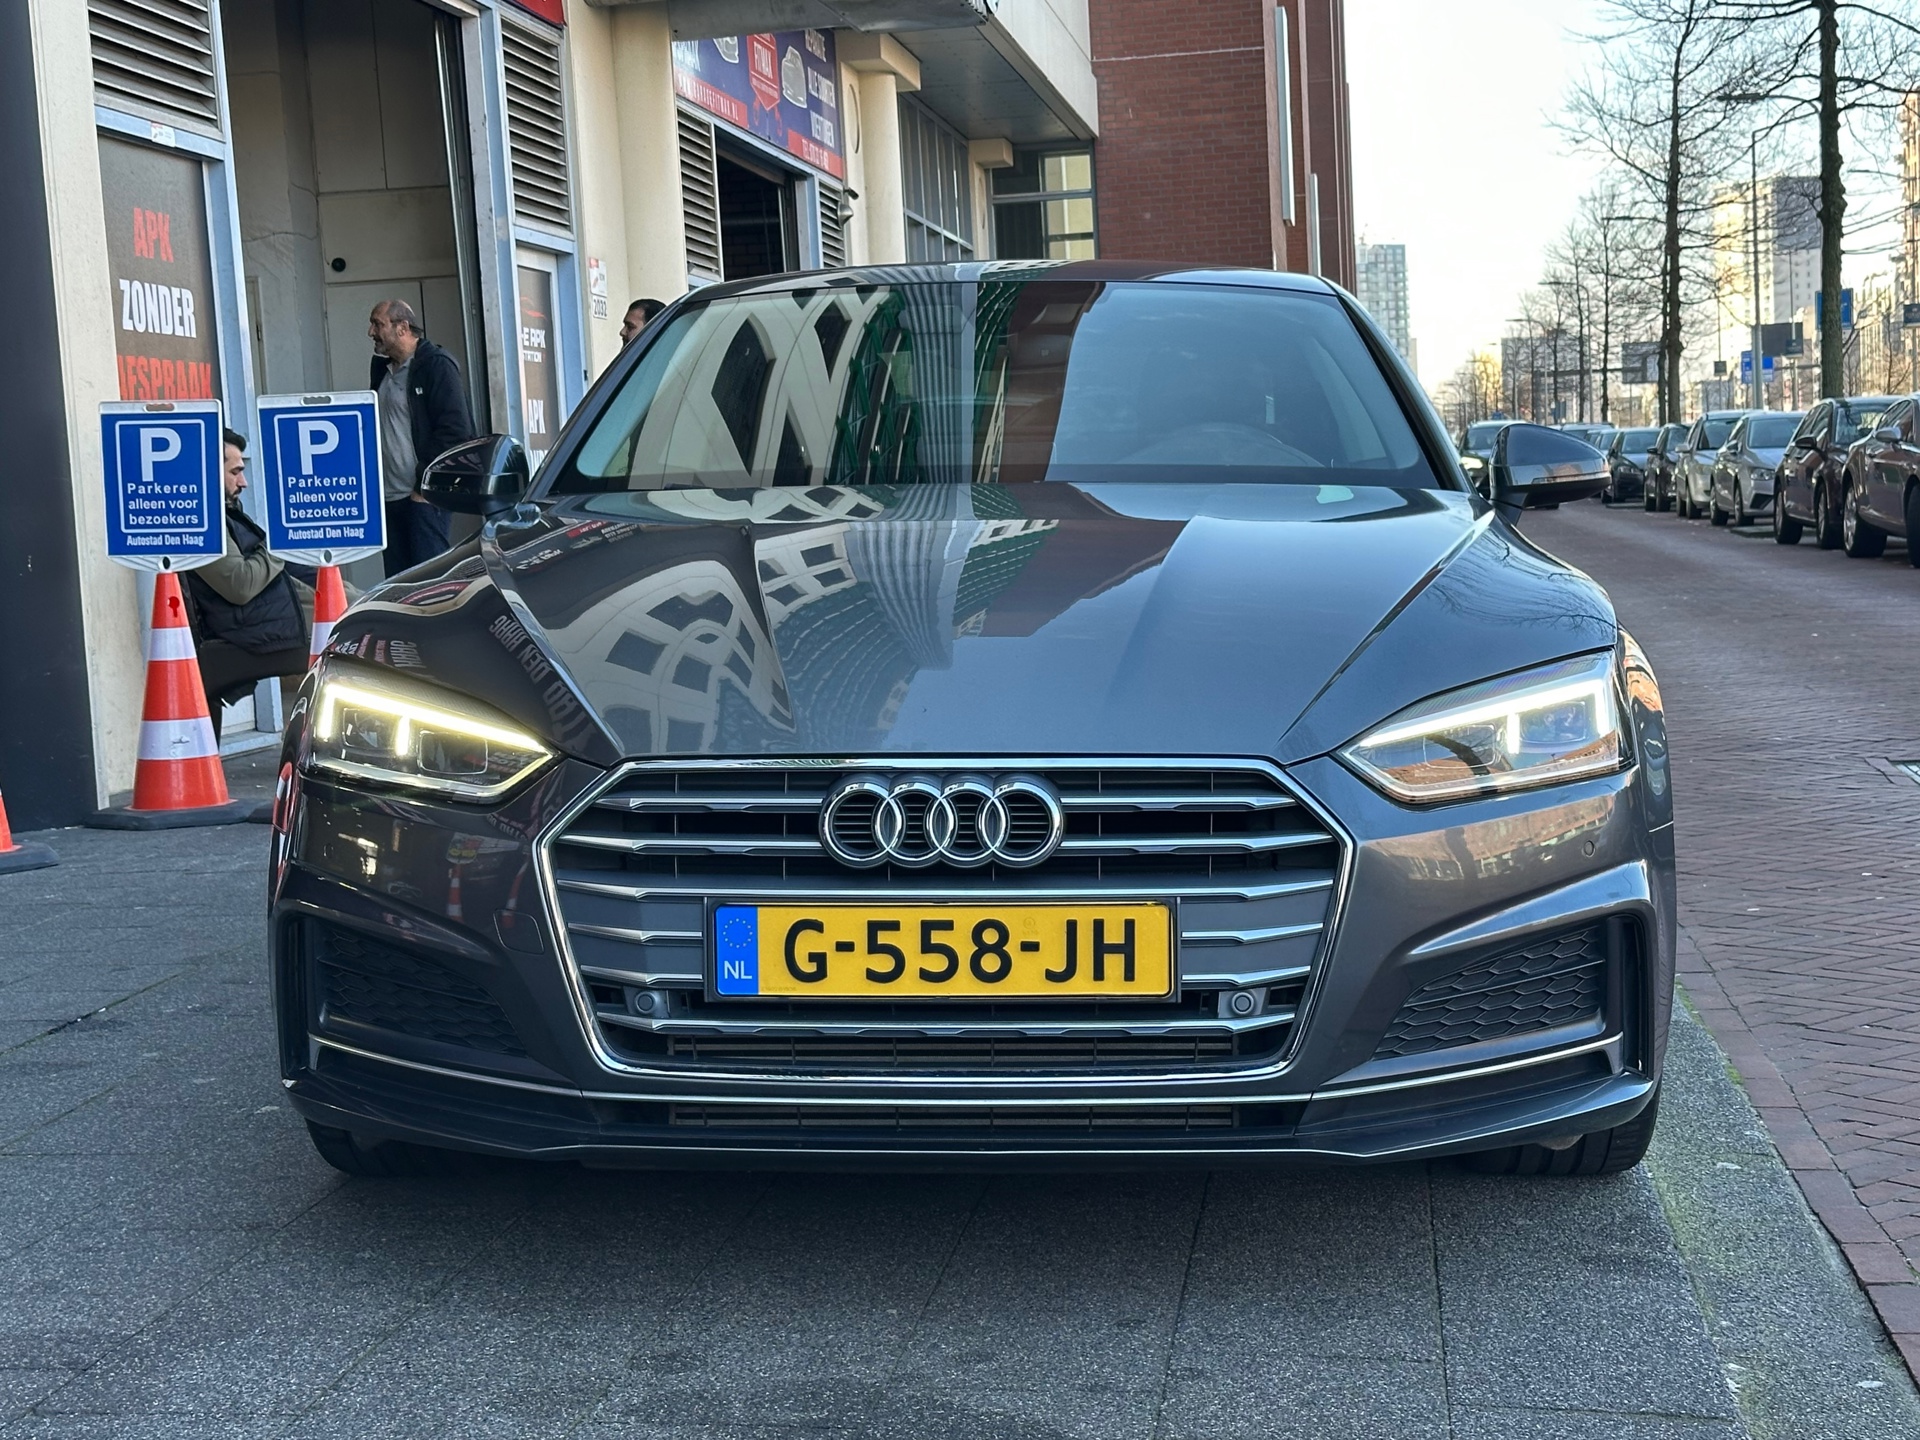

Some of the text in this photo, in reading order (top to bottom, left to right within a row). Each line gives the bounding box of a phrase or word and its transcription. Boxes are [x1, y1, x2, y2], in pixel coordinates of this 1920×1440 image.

[133, 207, 174, 263] APK
[119, 278, 197, 339] ZONDER
[530, 328, 546, 348] APK
[528, 399, 546, 434] APK
[140, 427, 182, 482] P
[298, 420, 340, 475] P
[127, 482, 198, 494] Parkeren
[287, 476, 357, 488] Parkeren
[128, 498, 199, 510] alleen voor
[289, 491, 358, 503] alleen voor
[129, 513, 199, 525] bezoekers
[290, 506, 359, 519] bezoekers
[126, 534, 204, 547] Autostad Den Haag
[288, 526, 365, 540] Autostad Den Haag
[784, 918, 1136, 984] G-558-JH
[723, 960, 753, 979] NL
